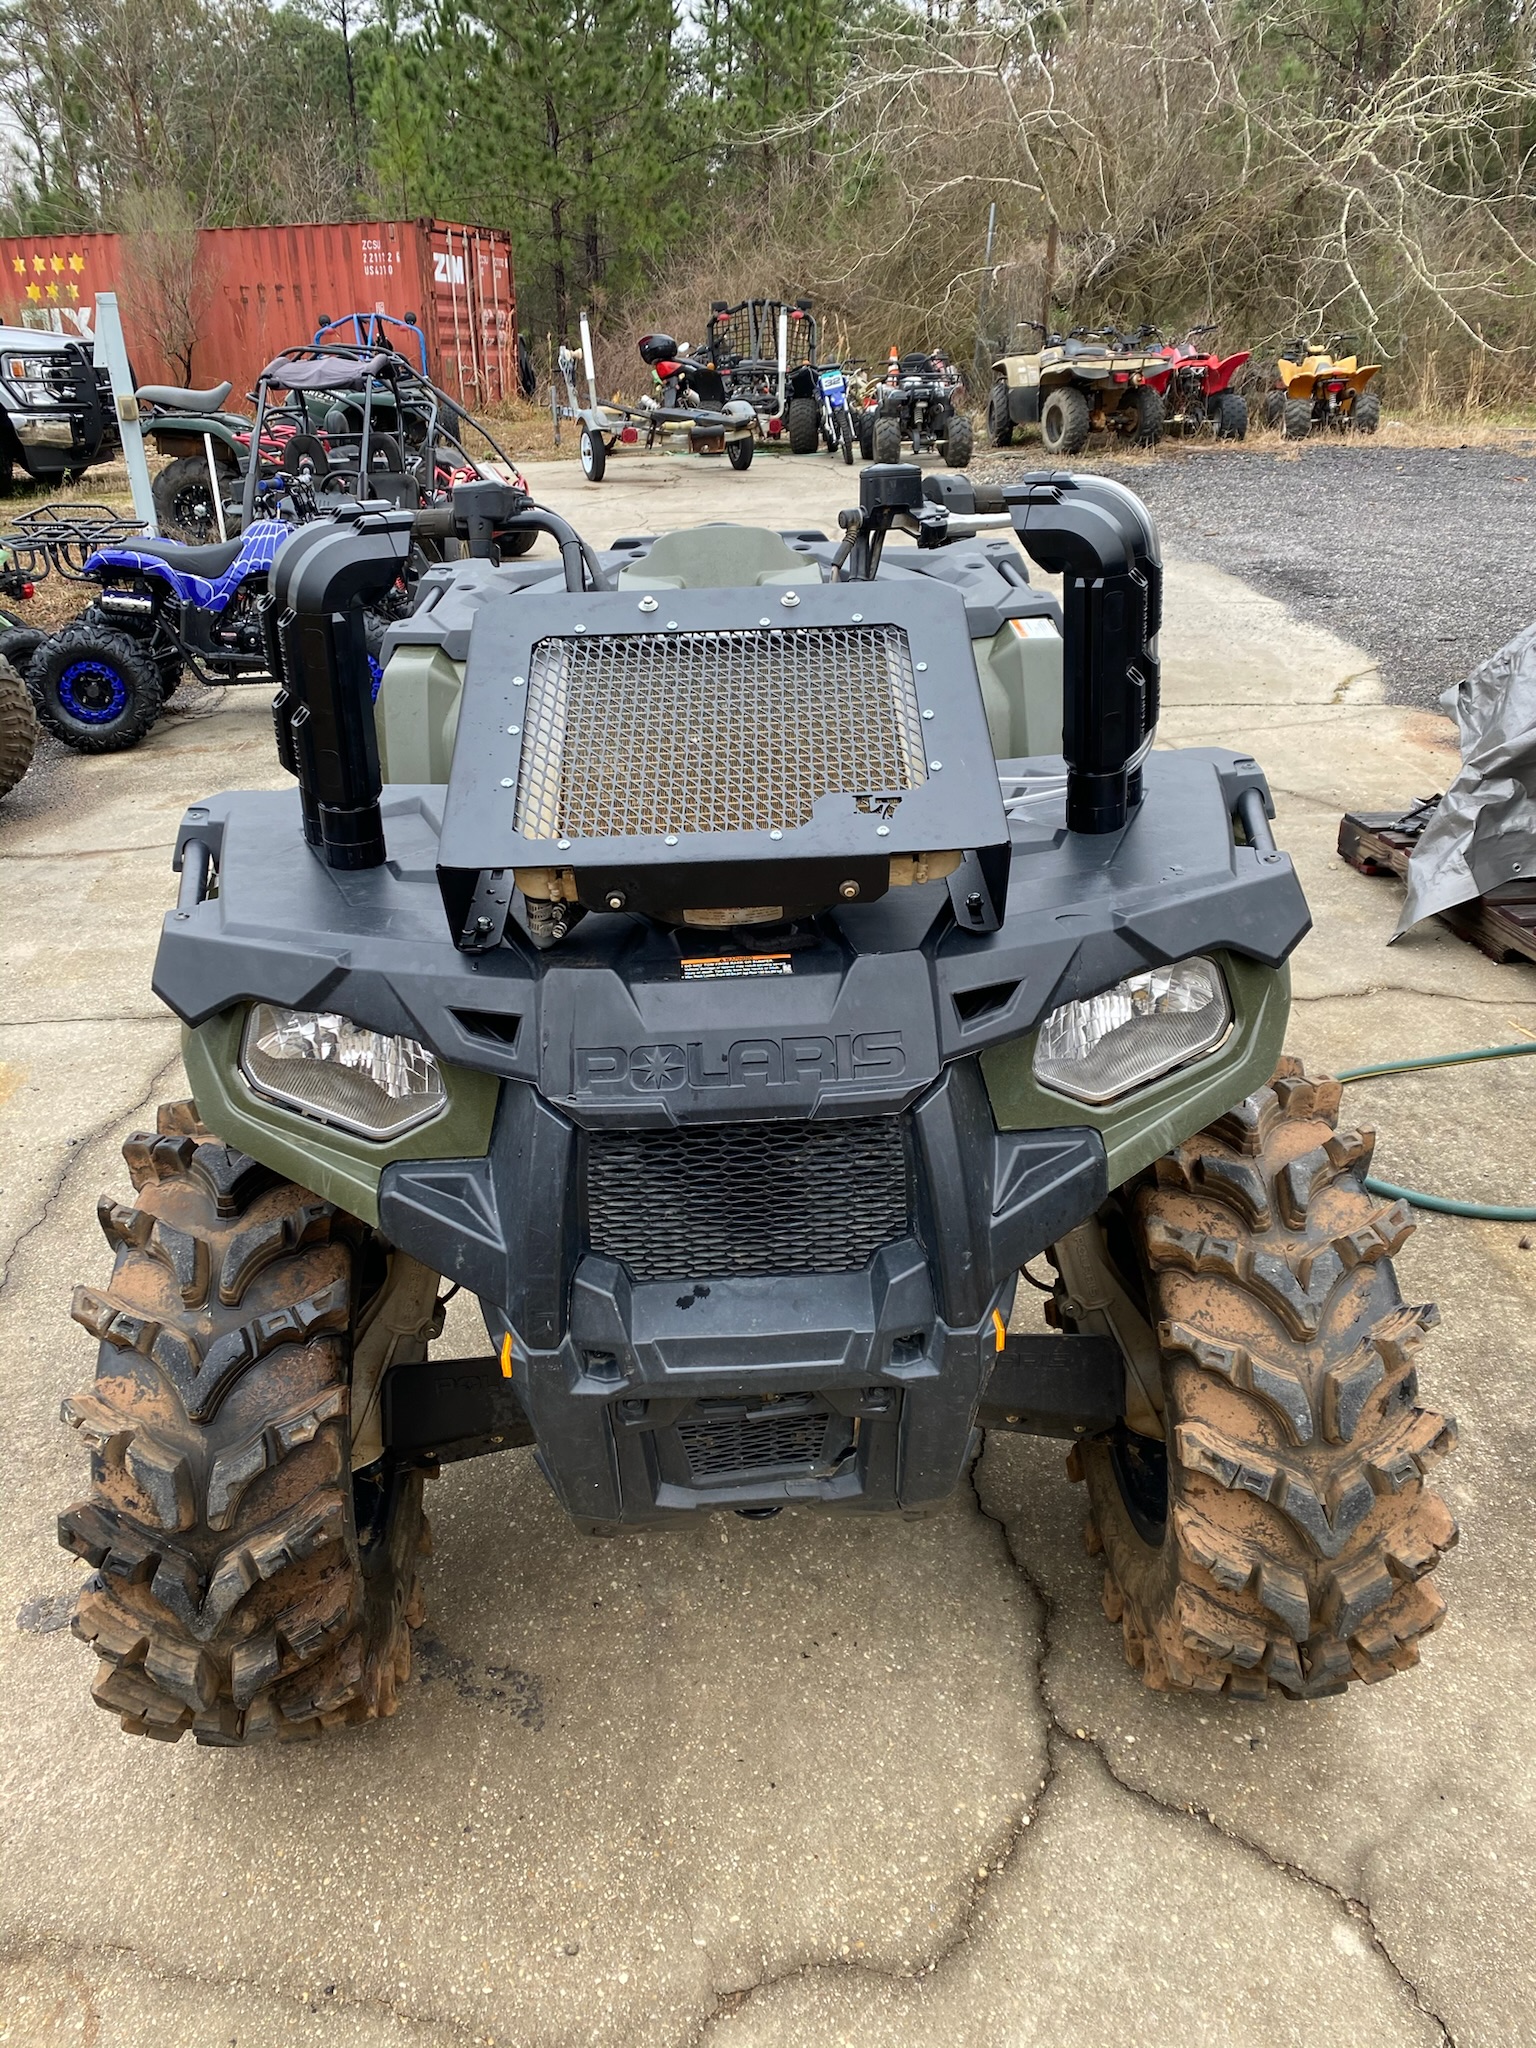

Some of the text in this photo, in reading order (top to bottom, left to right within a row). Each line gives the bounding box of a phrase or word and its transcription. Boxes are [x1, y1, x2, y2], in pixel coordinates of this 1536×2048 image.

[433, 252, 465, 285] ZIM
[824, 377, 841, 388] 32
[574, 1030, 907, 1094] POLARIS
